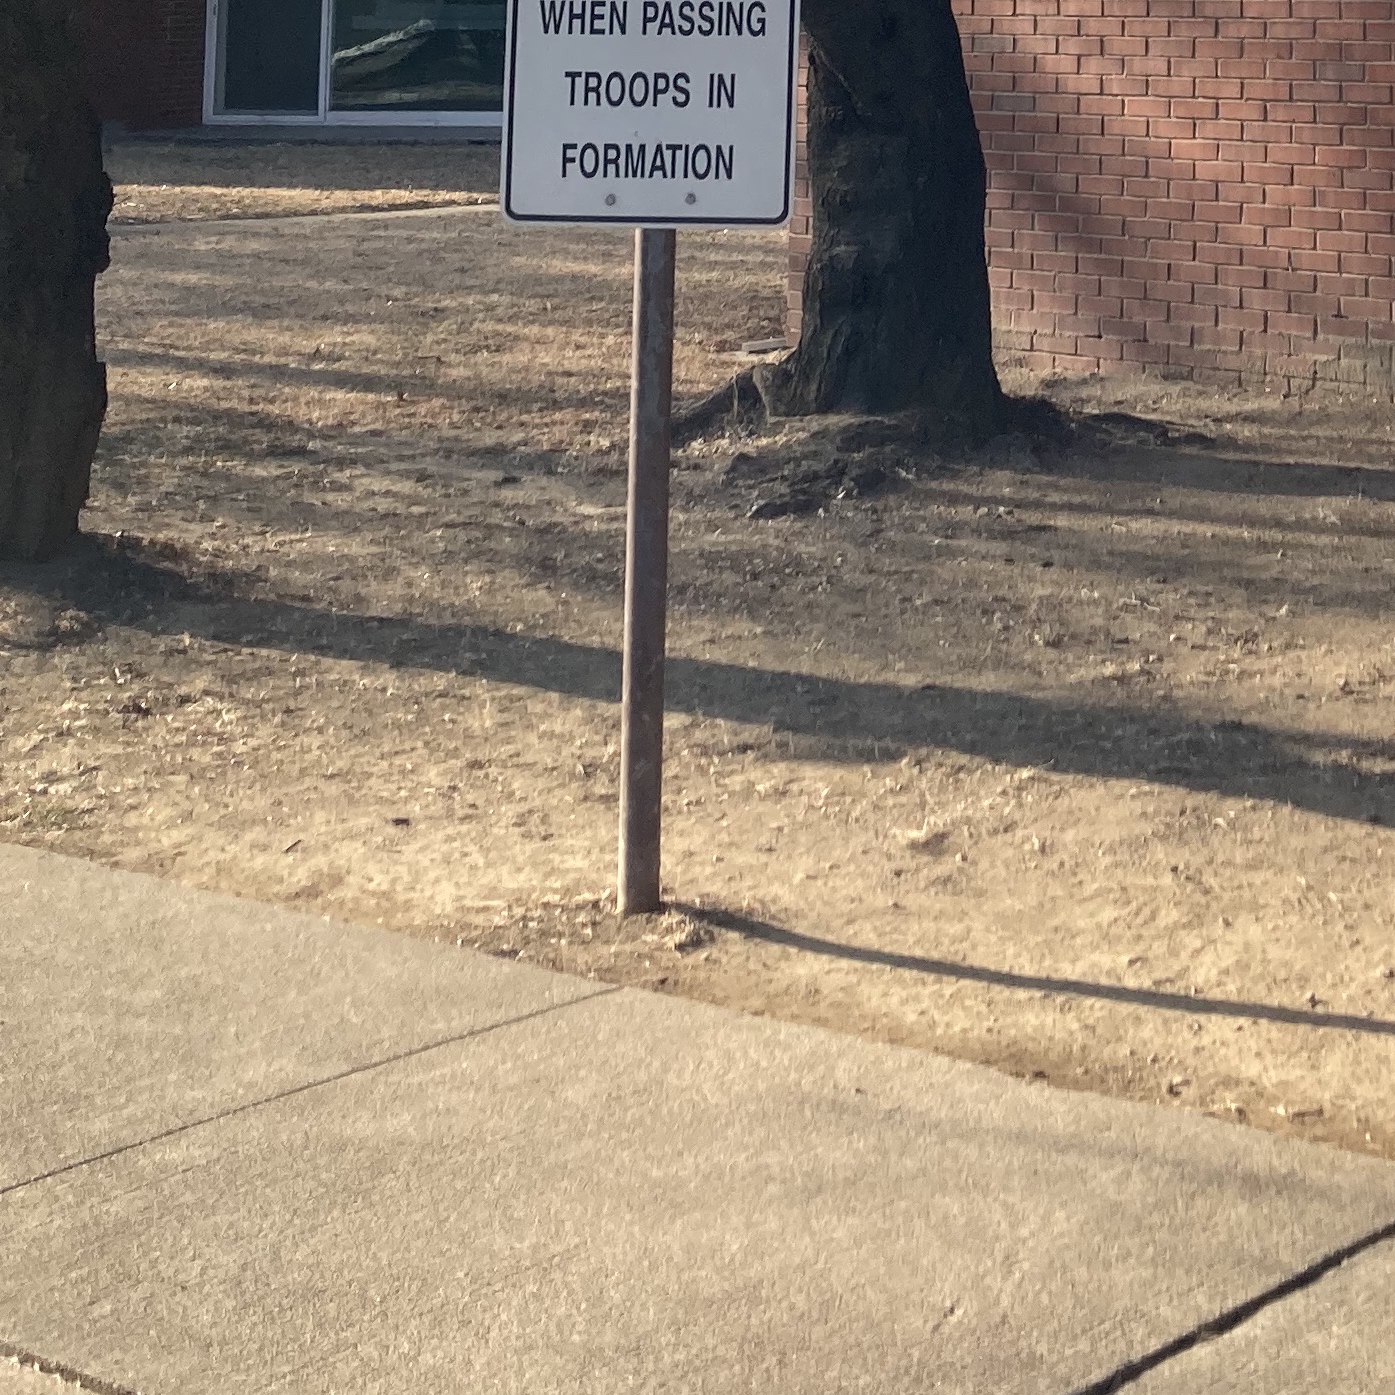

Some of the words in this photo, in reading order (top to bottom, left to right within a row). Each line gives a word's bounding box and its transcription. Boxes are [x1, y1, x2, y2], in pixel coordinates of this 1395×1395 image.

[539, 0, 628, 36] WHEN
[641, 0, 767, 38] PASSING
[564, 70, 691, 109] TROOPS
[707, 73, 736, 109] IN
[561, 142, 734, 181] FORMATION
